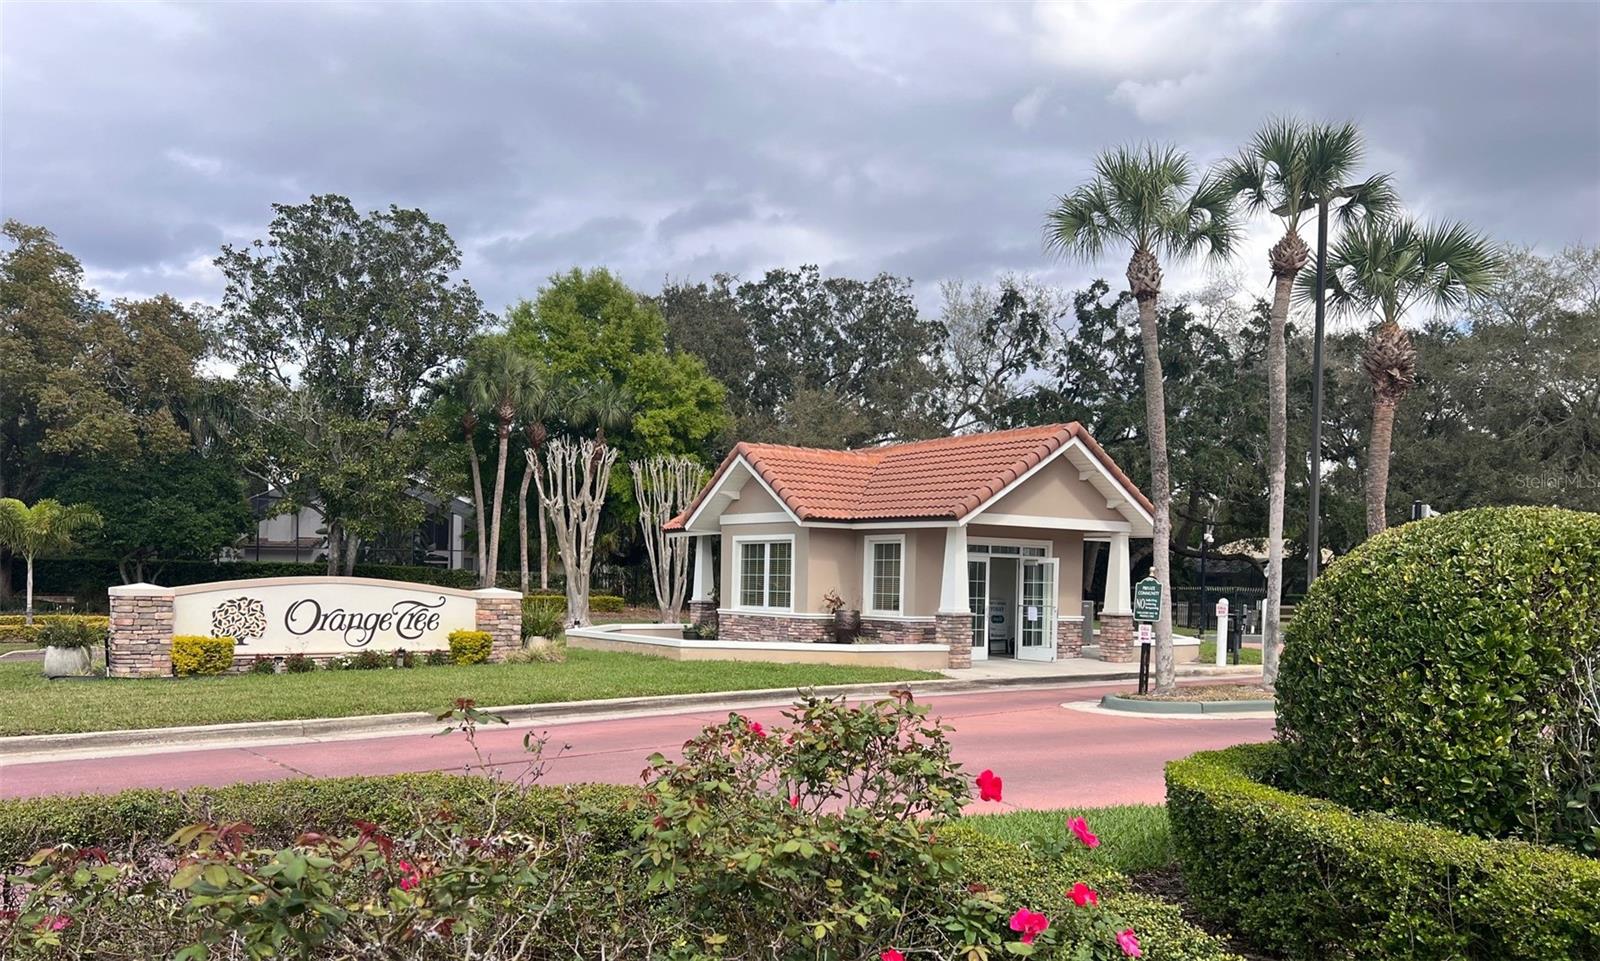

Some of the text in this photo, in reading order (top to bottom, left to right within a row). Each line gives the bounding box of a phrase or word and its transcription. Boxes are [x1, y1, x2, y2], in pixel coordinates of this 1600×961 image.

[1136, 598, 1146, 609] NO
[285, 596, 446, 647] Orange Tree
